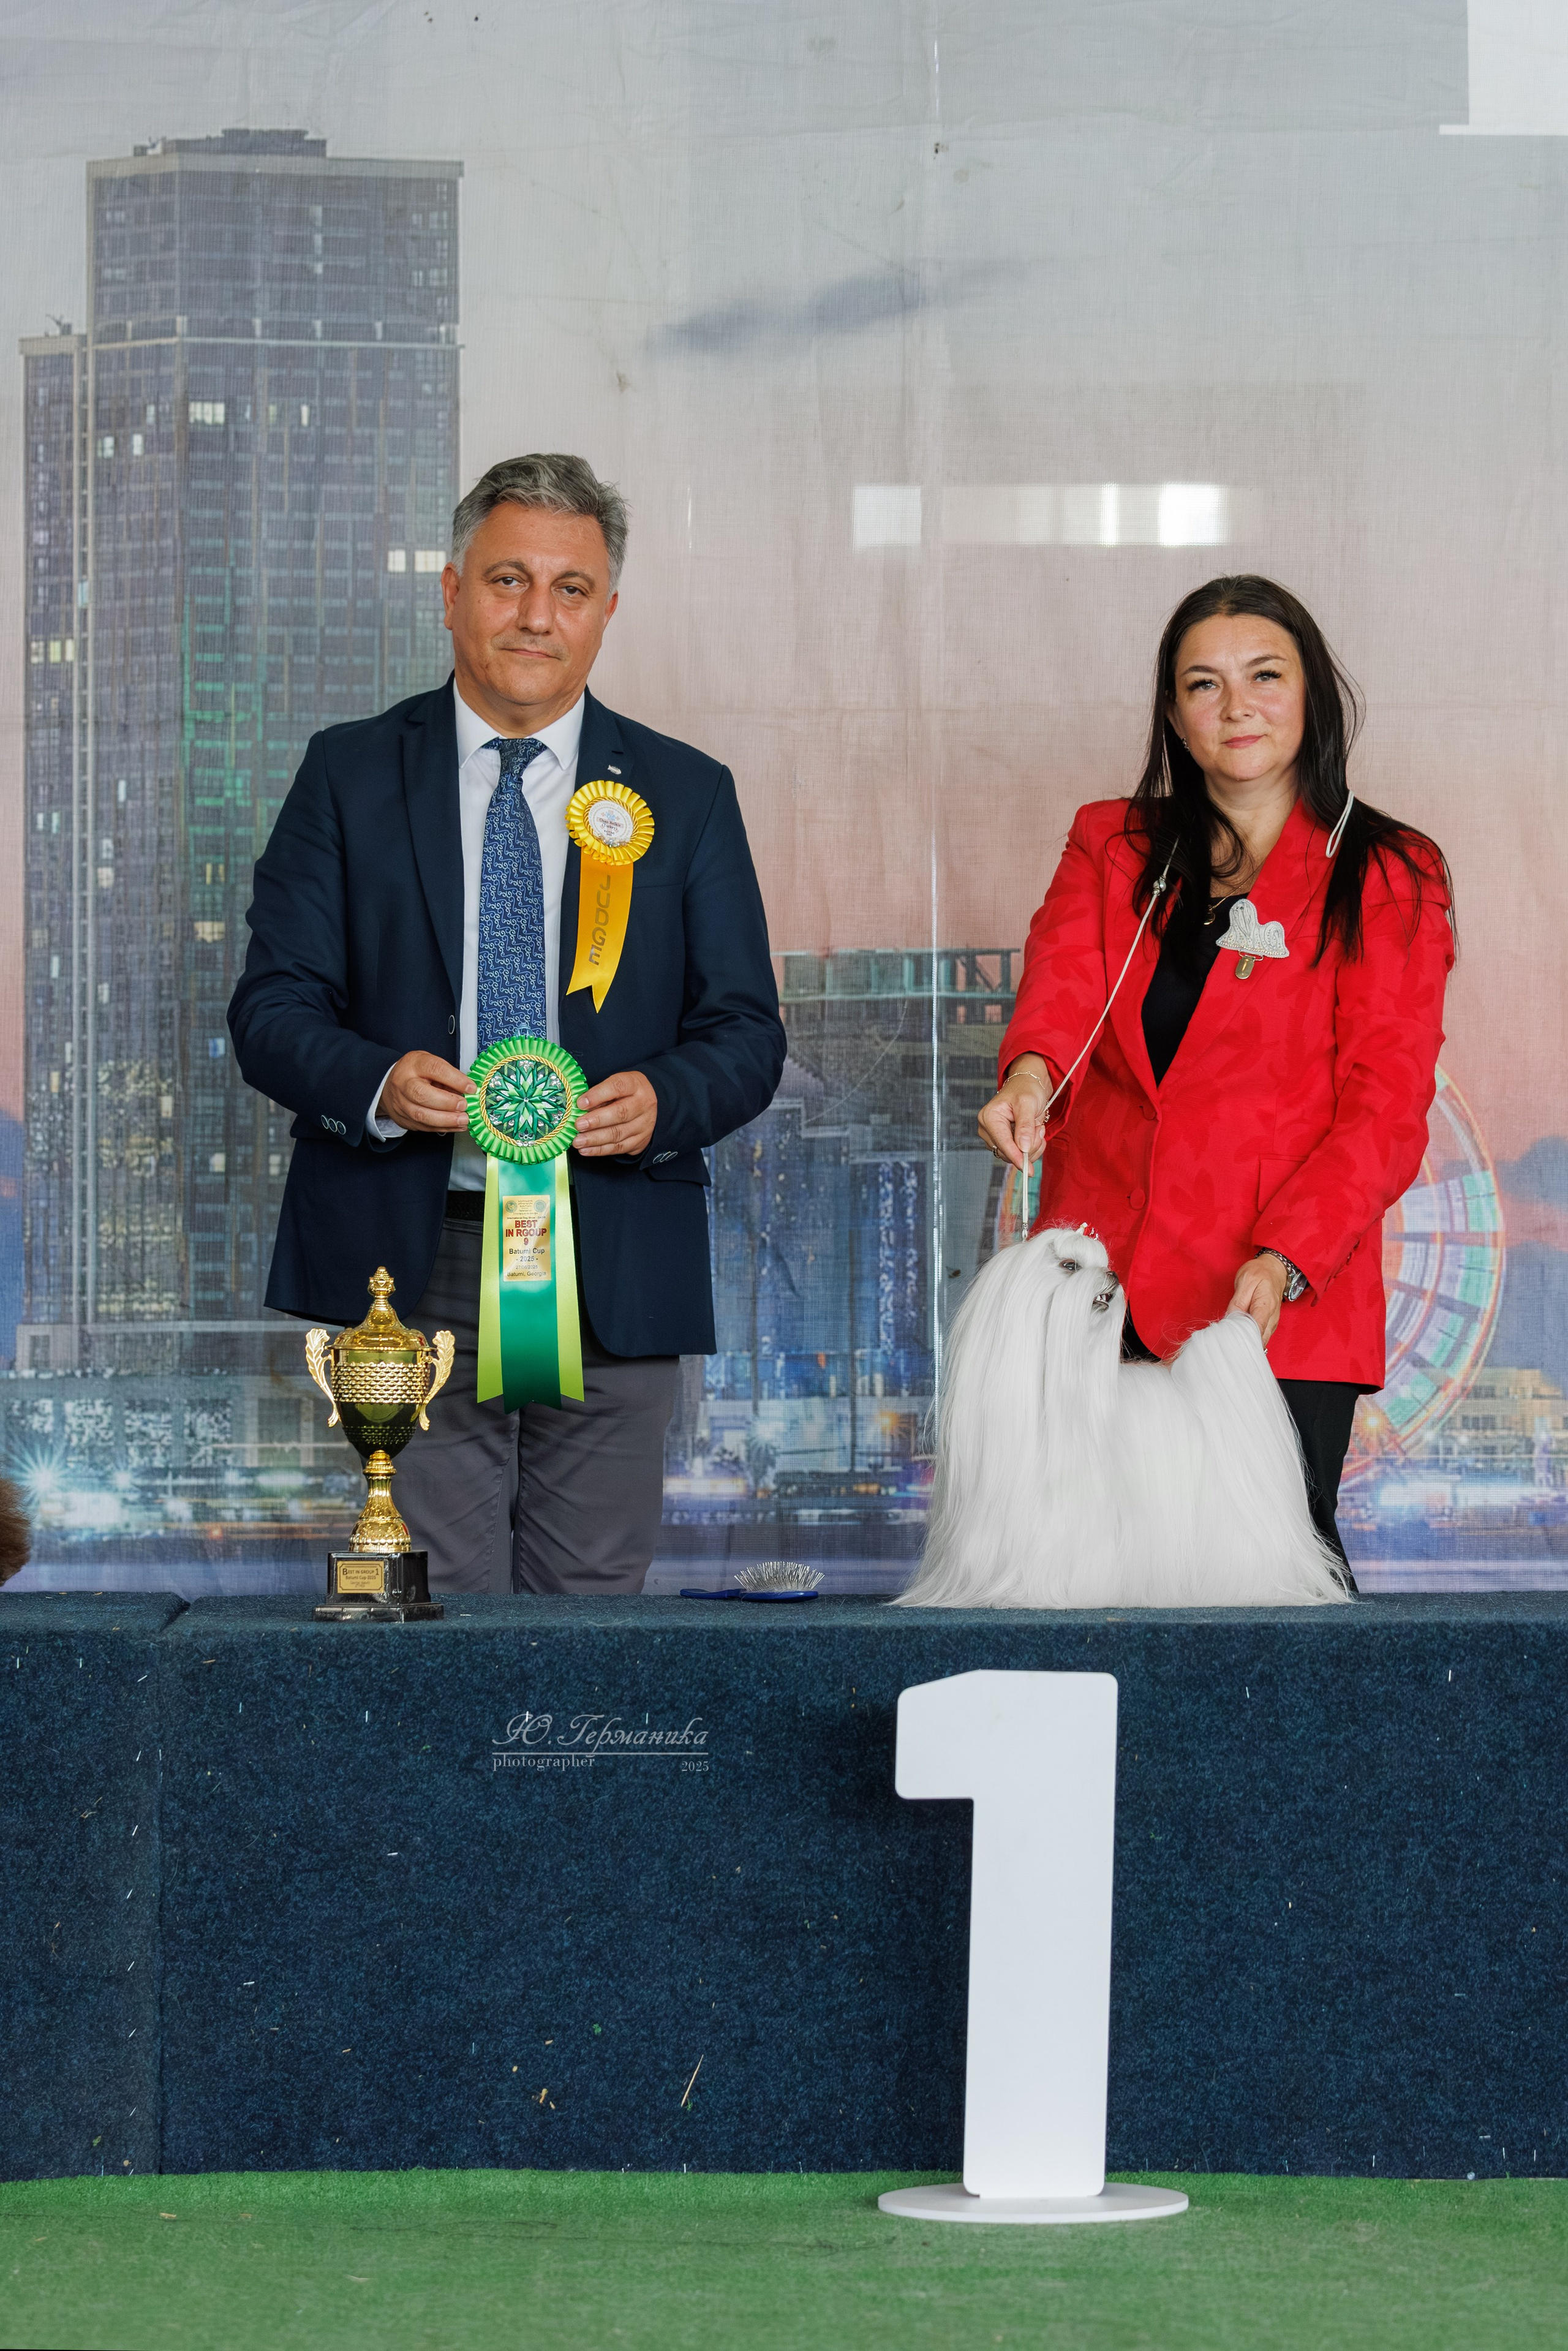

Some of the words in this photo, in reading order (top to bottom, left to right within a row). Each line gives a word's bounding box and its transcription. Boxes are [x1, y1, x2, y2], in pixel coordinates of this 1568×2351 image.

[589, 875, 611, 966] JUDGE
[515, 1220, 538, 1229] BEST
[506, 1228, 514, 1237] IN
[516, 1228, 548, 1237] RGOUP
[523, 1237, 529, 1246] 9
[896, 1669, 1119, 2198] 1
